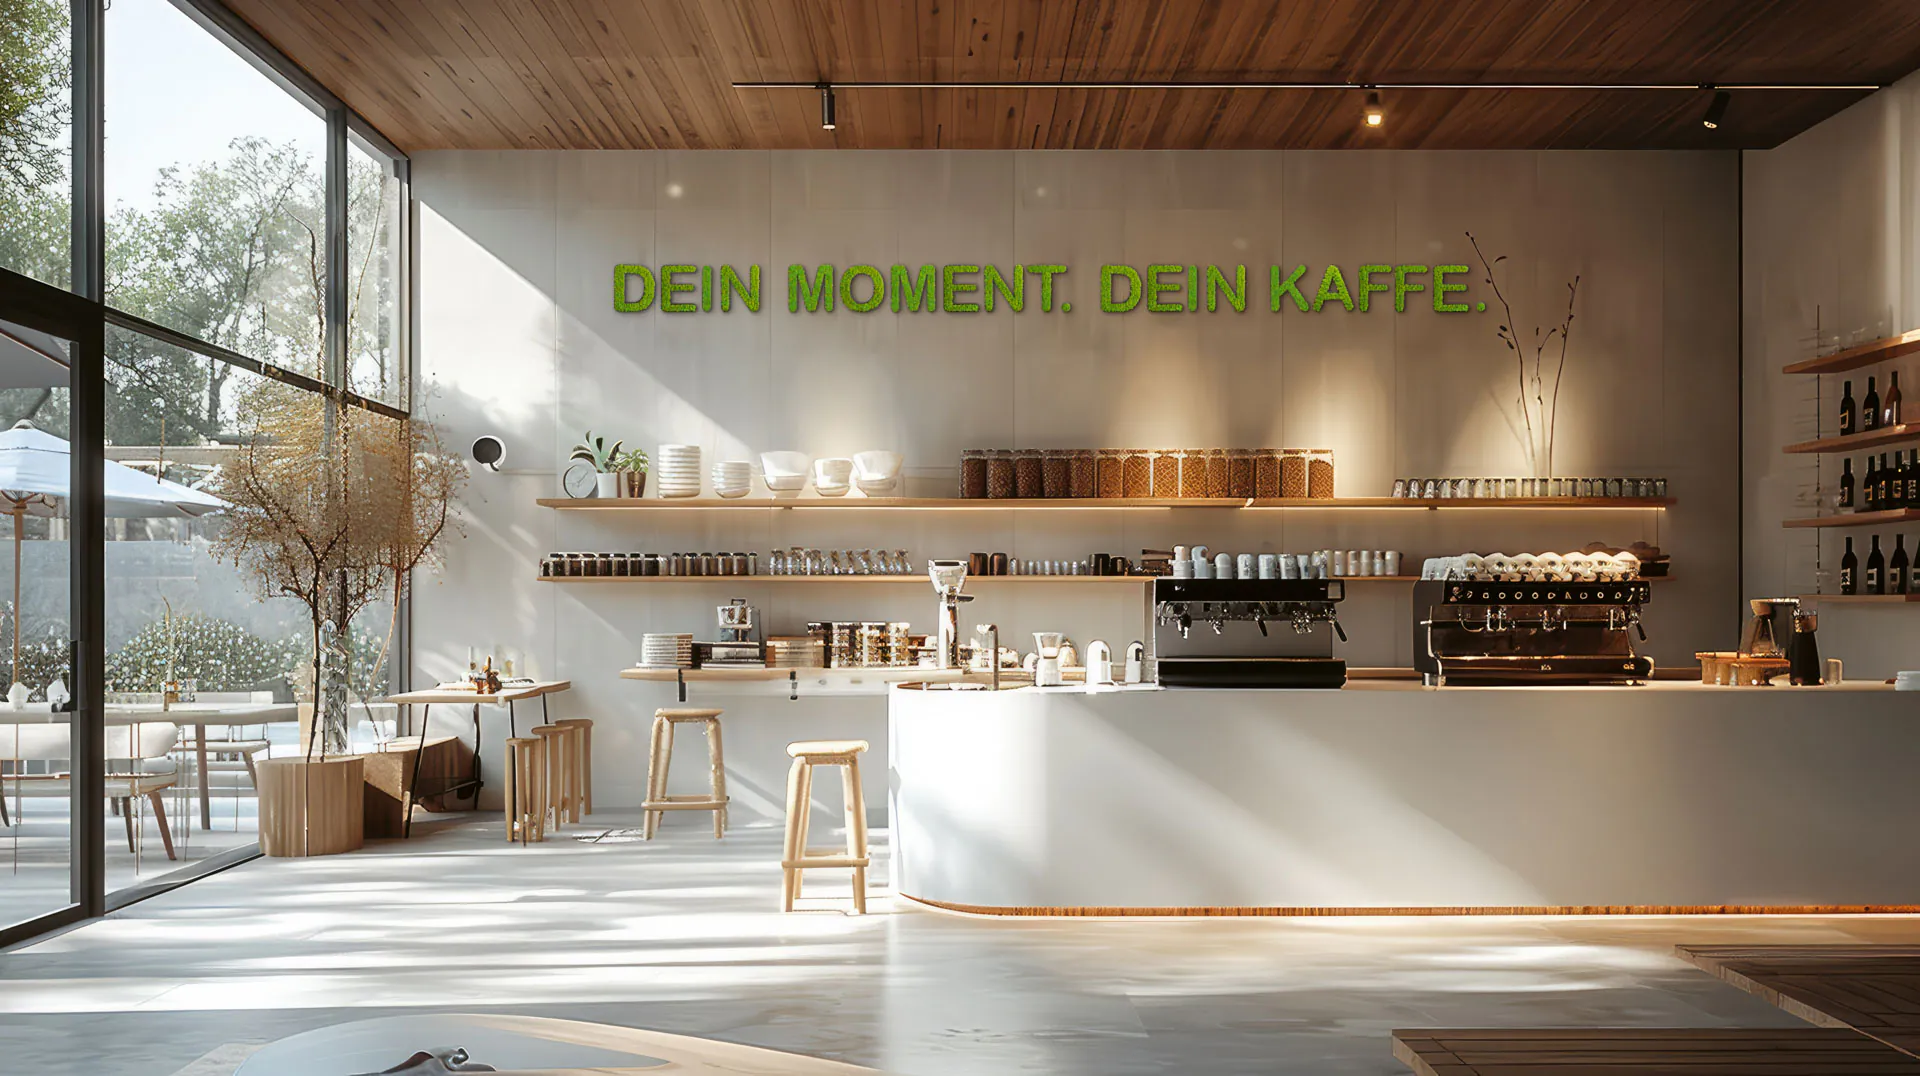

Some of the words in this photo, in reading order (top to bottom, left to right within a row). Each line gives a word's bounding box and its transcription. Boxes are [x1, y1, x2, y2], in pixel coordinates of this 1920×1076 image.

[614, 264, 761, 313] DEIN
[788, 264, 1073, 313] MOMENT.
[1101, 264, 1246, 313] DEIN
[1270, 264, 1486, 313] KAFFE.
